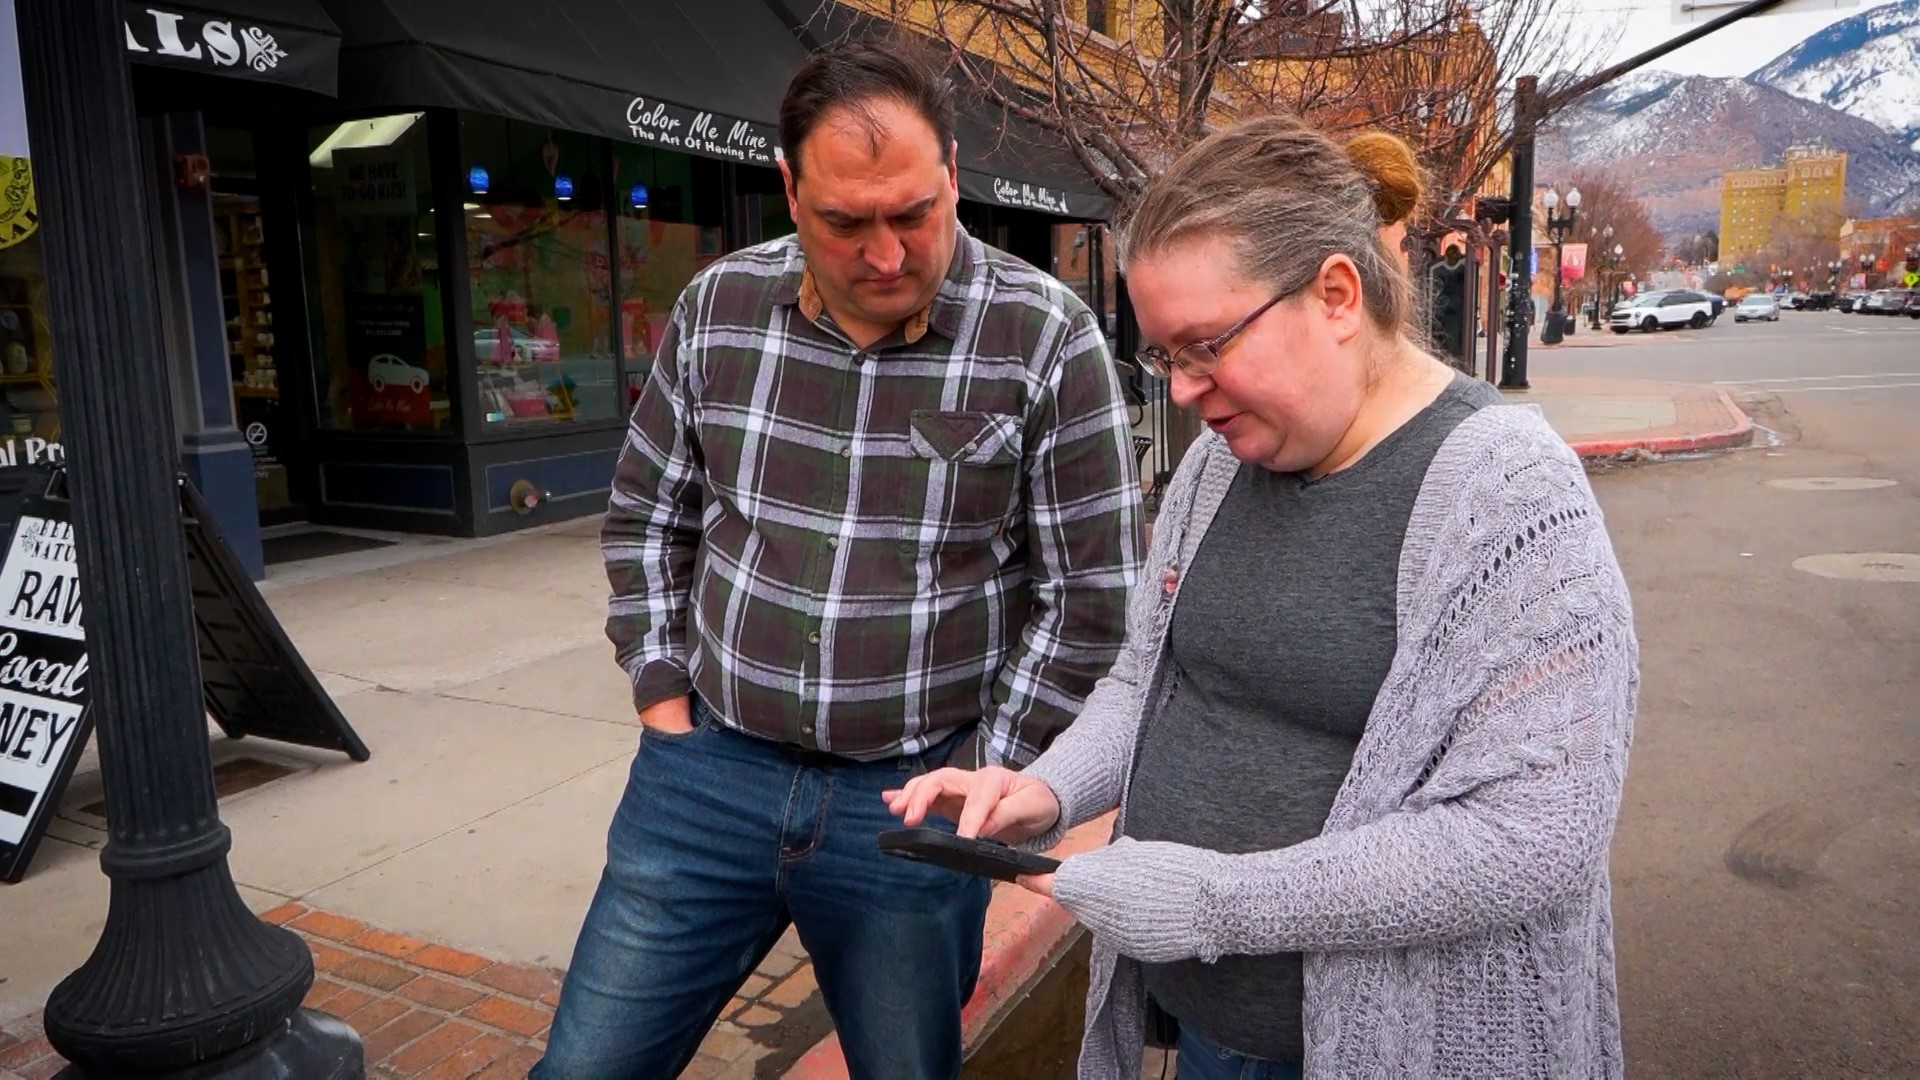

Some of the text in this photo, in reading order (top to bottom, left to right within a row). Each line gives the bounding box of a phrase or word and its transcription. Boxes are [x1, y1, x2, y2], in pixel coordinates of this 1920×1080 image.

[626, 97, 768, 149] Color Me Mine
[629, 125, 769, 162] The Art Of Having Fun
[368, 161, 398, 179] HAVE
[378, 181, 406, 200] KITS!
[994, 177, 1019, 196] Color
